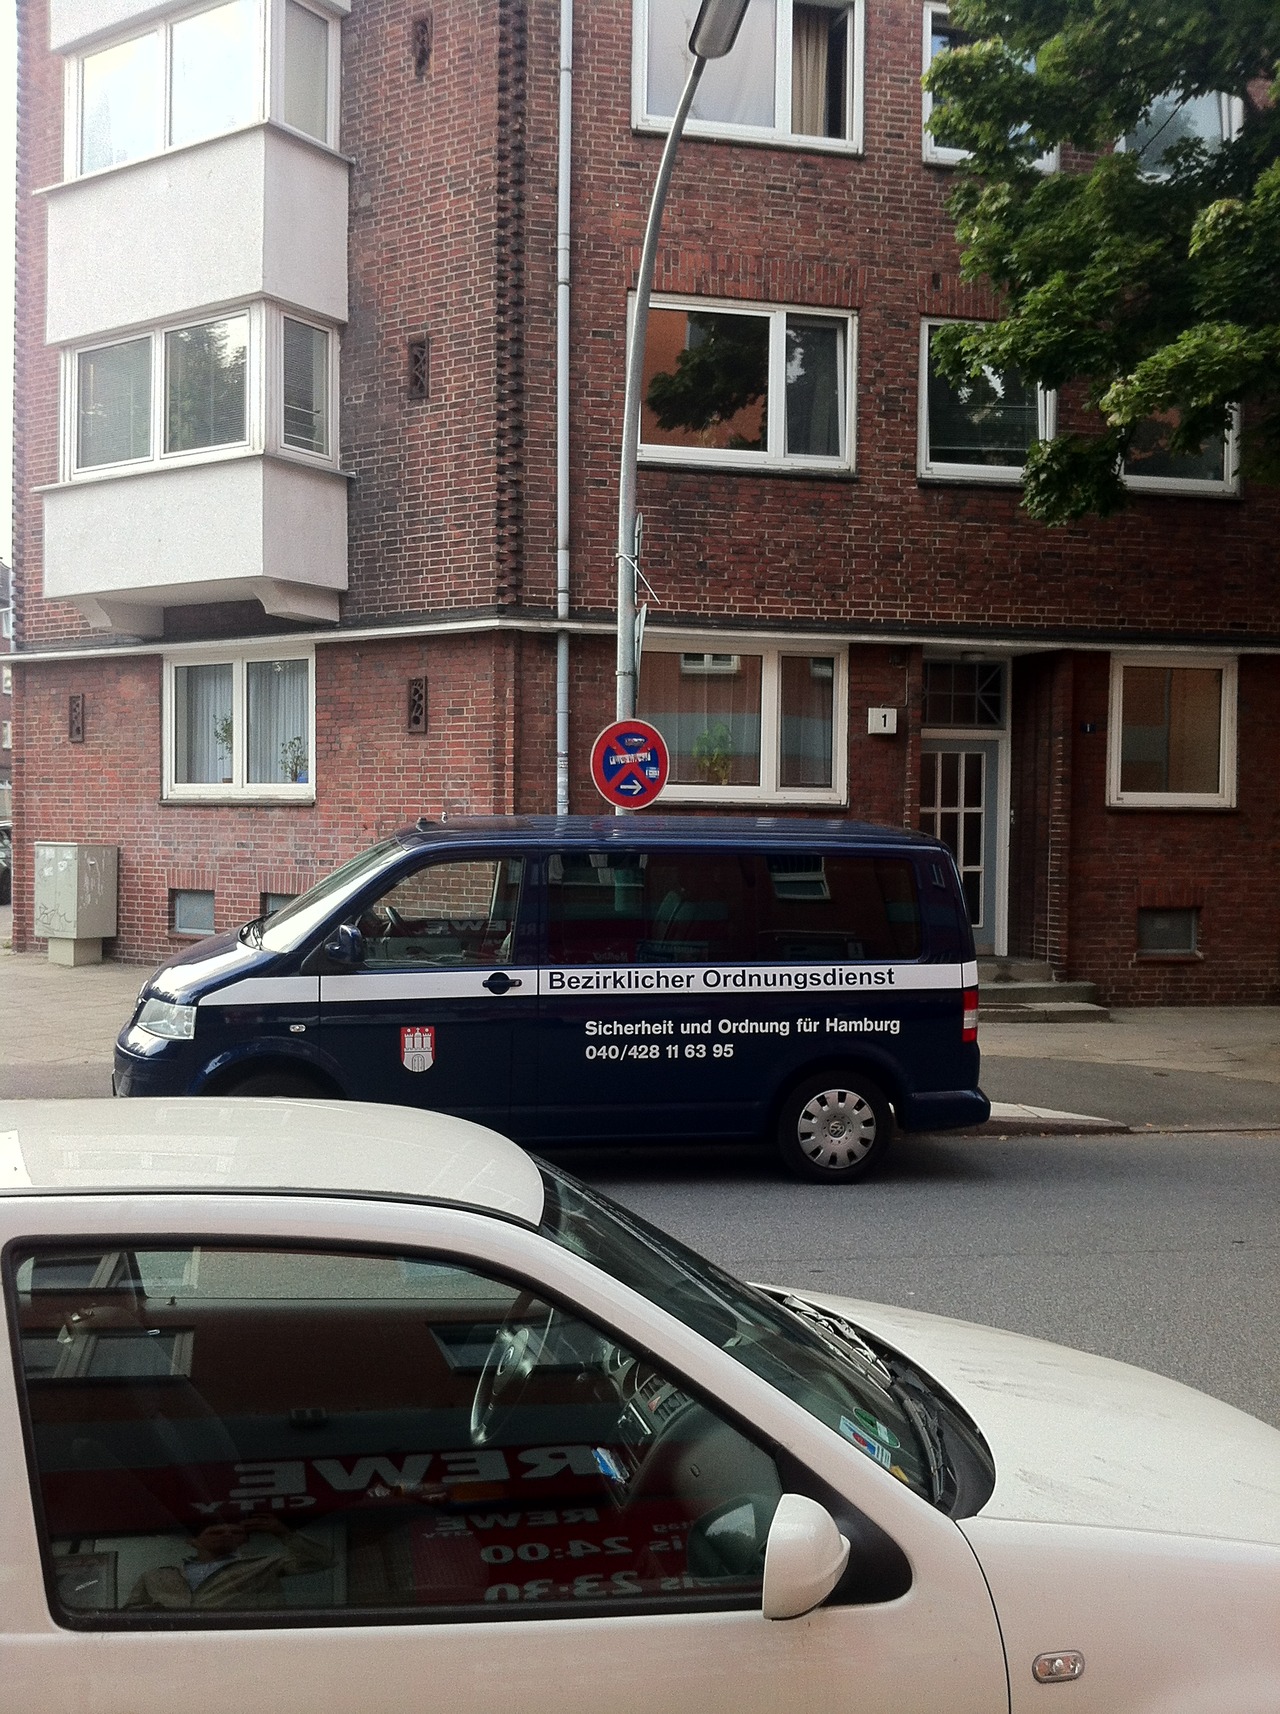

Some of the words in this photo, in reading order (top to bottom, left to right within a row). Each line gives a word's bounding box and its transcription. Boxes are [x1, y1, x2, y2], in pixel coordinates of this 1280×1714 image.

[881, 713, 888, 728] 1
[549, 970, 695, 990] Bezirklicher
[702, 968, 895, 989] Ordnungsdienst
[585, 1020, 674, 1036] Sicherheit
[680, 1019, 712, 1034] und
[718, 1019, 790, 1036] Ordnung
[796, 1018, 819, 1033] für
[825, 1017, 901, 1034] Hamburg
[585, 1045, 660, 1060] 040/428
[665, 1044, 679, 1059] 11
[684, 1044, 706, 1059] 63
[712, 1043, 734, 1058] 95
